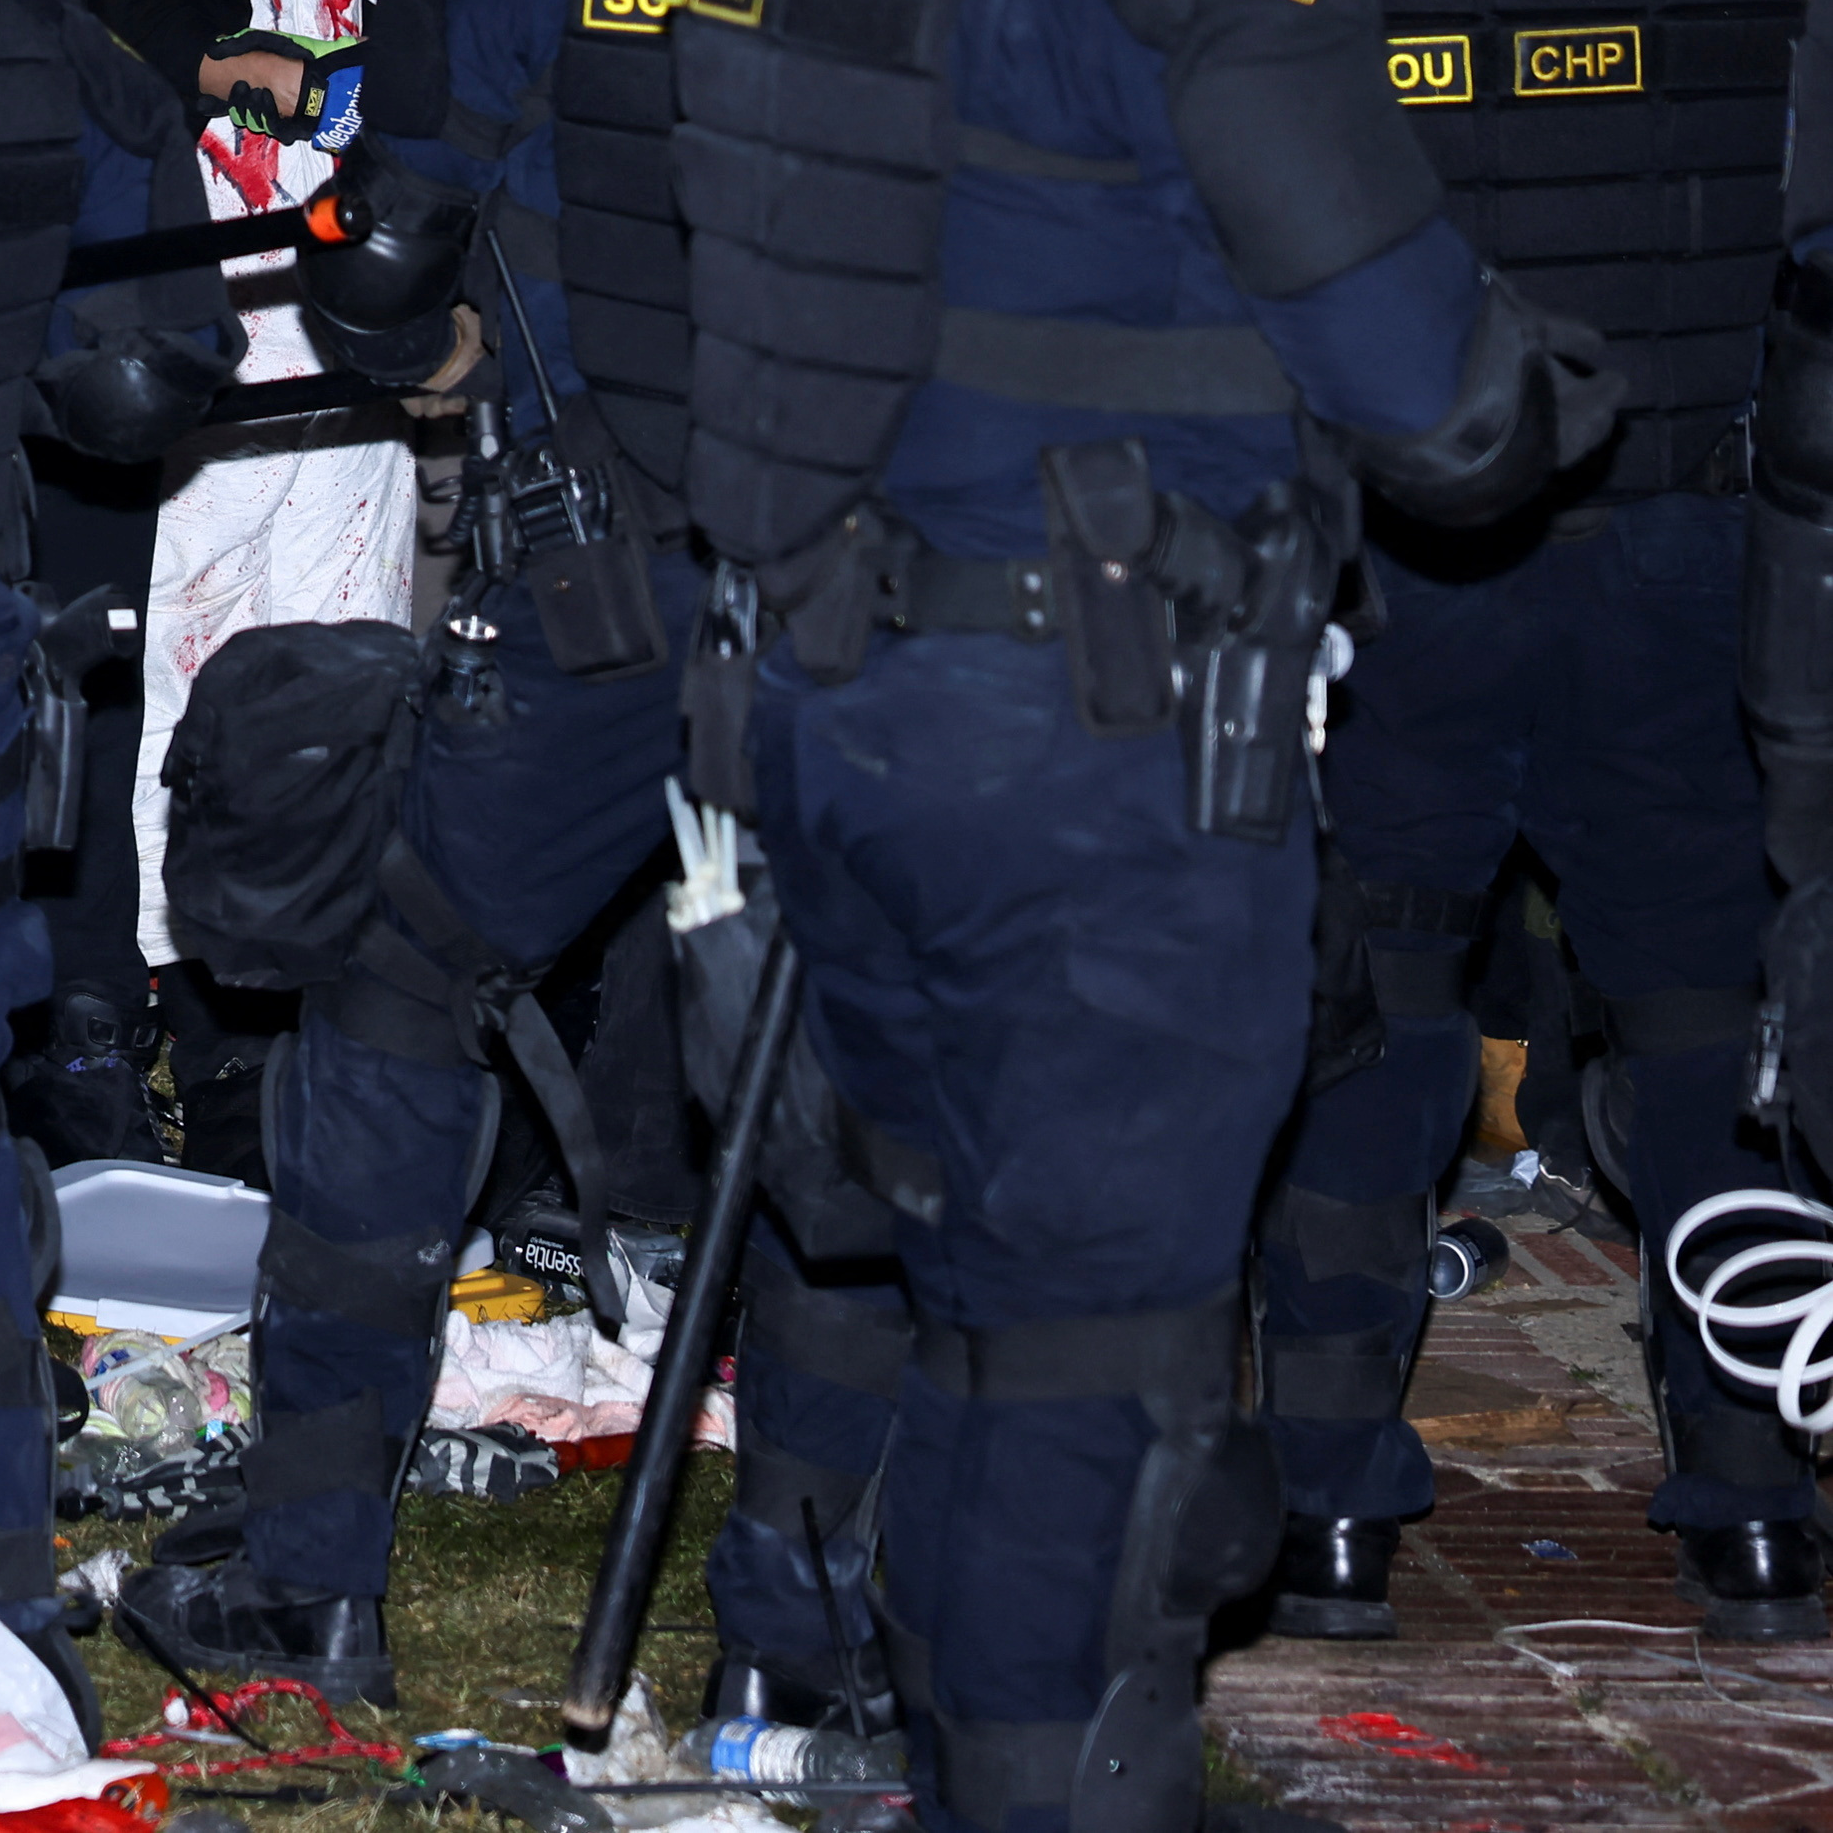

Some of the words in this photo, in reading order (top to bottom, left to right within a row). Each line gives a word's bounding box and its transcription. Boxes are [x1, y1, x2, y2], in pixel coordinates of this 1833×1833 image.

[1387, 51, 1453, 90] OU
[1531, 42, 1625, 81] CHP
[525, 1243, 585, 1278] ssentia
